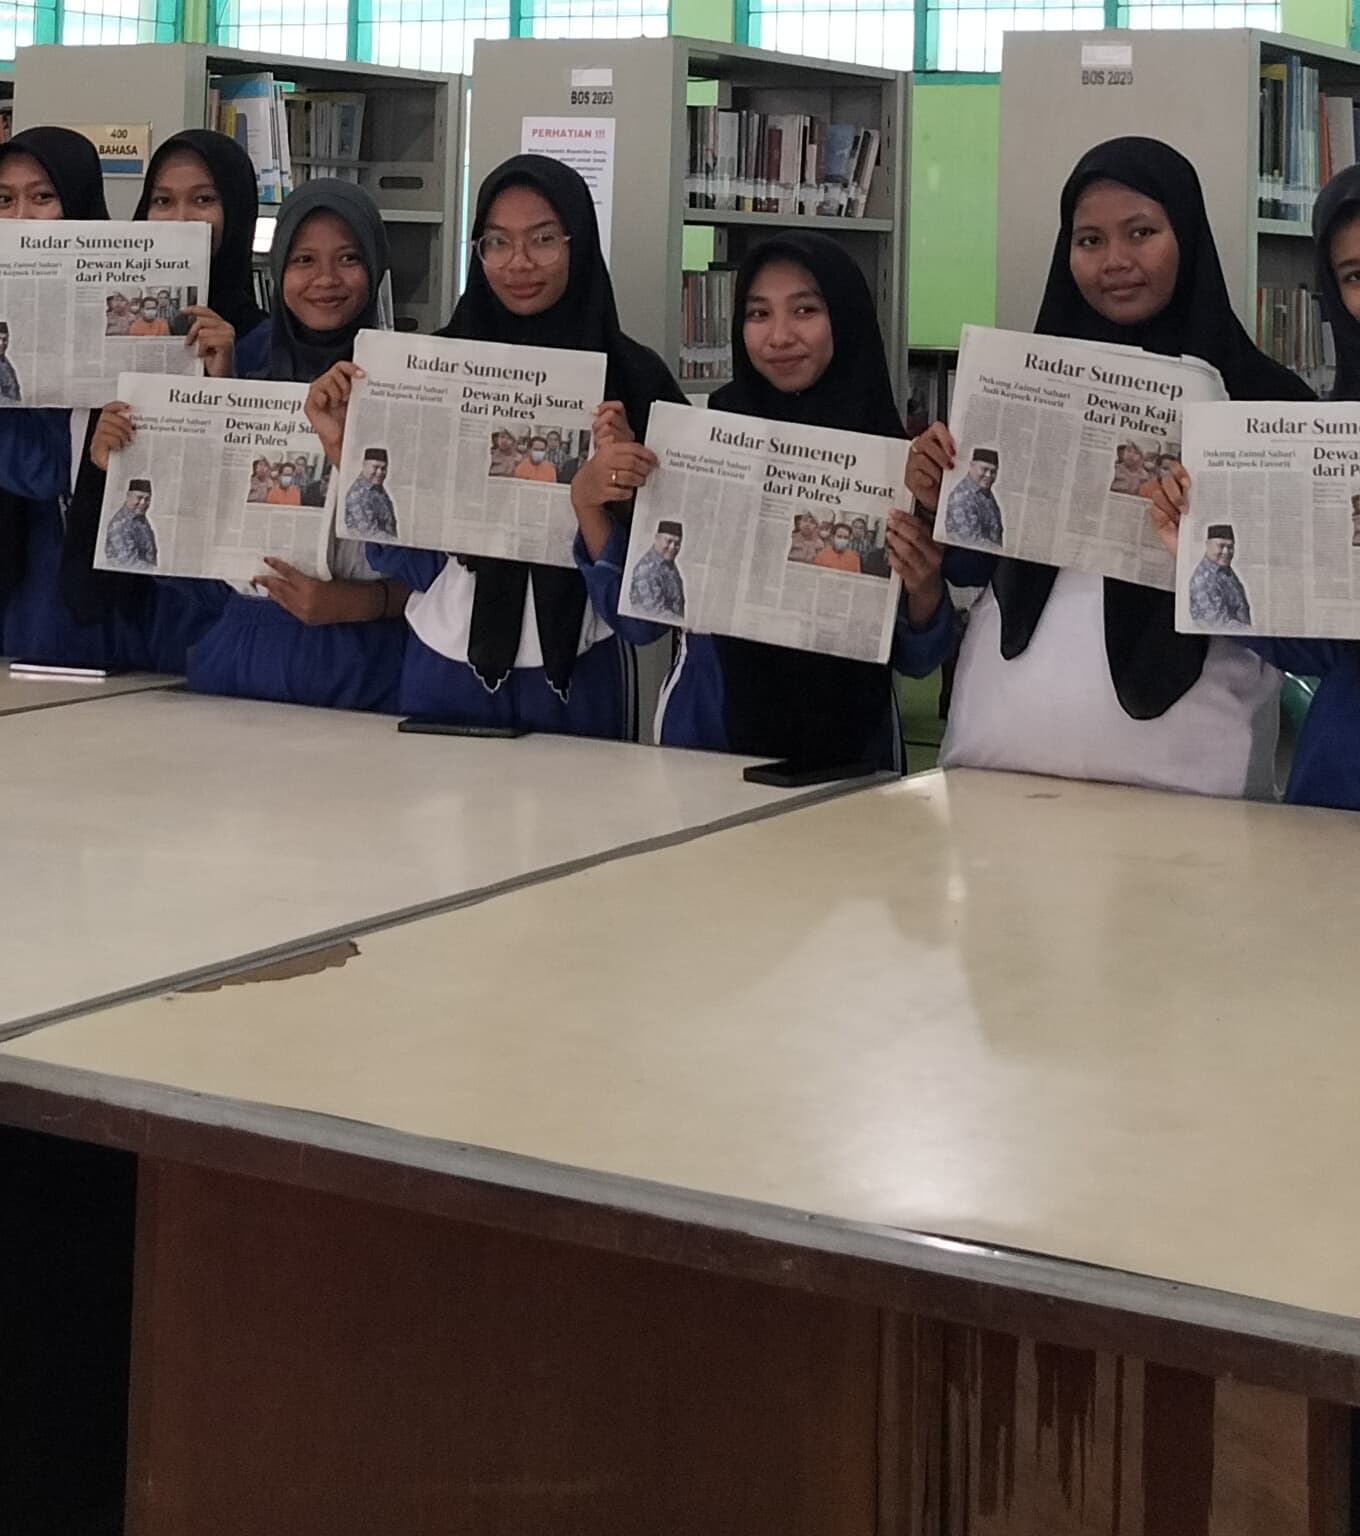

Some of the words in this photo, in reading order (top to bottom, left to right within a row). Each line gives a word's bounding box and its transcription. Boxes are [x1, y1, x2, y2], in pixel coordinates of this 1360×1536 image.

[1082, 70, 1105, 85] BOS
[570, 91, 590, 104] BOS
[110, 129, 128, 138] 400
[532, 128, 592, 139] PERHATIAN
[99, 144, 138, 155] BAHASA
[20, 235, 71, 250] Radar
[75, 235, 155, 252] Sumenep
[76, 259, 122, 270] Dewan
[125, 259, 152, 272] Kaji
[154, 259, 192, 270] Surat
[75, 271, 102, 283] dari
[105, 271, 147, 283] Polres
[406, 354, 459, 374] Radar
[462, 360, 548, 387] Sumenep
[1024, 352, 1086, 379] Radar
[1088, 364, 1184, 401] Sumenep
[169, 388, 222, 406] Radar
[226, 392, 302, 414] Sumenep
[462, 386, 511, 402] Dewan
[513, 391, 543, 408] Kaji
[545, 395, 585, 411] Surat
[460, 402, 489, 416] dari
[492, 405, 536, 420] Polres
[1086, 392, 1142, 416] Dewan
[1144, 404, 1178, 424] Kaji
[225, 417, 271, 432] Dewan
[273, 420, 296, 435] Kaji
[1083, 408, 1116, 426] dari
[1119, 416, 1168, 437] Polres
[1246, 418, 1308, 435] Radar
[224, 432, 251, 444] dari
[255, 434, 288, 446] Polres
[709, 426, 765, 452] Radar
[769, 436, 858, 470] Sumenep
[1312, 464, 1345, 477] dari
[765, 464, 817, 485] Dewan
[820, 474, 851, 493] Kaji
[854, 479, 896, 499] Surat
[763, 480, 793, 497] dari
[796, 486, 842, 505] Polres
